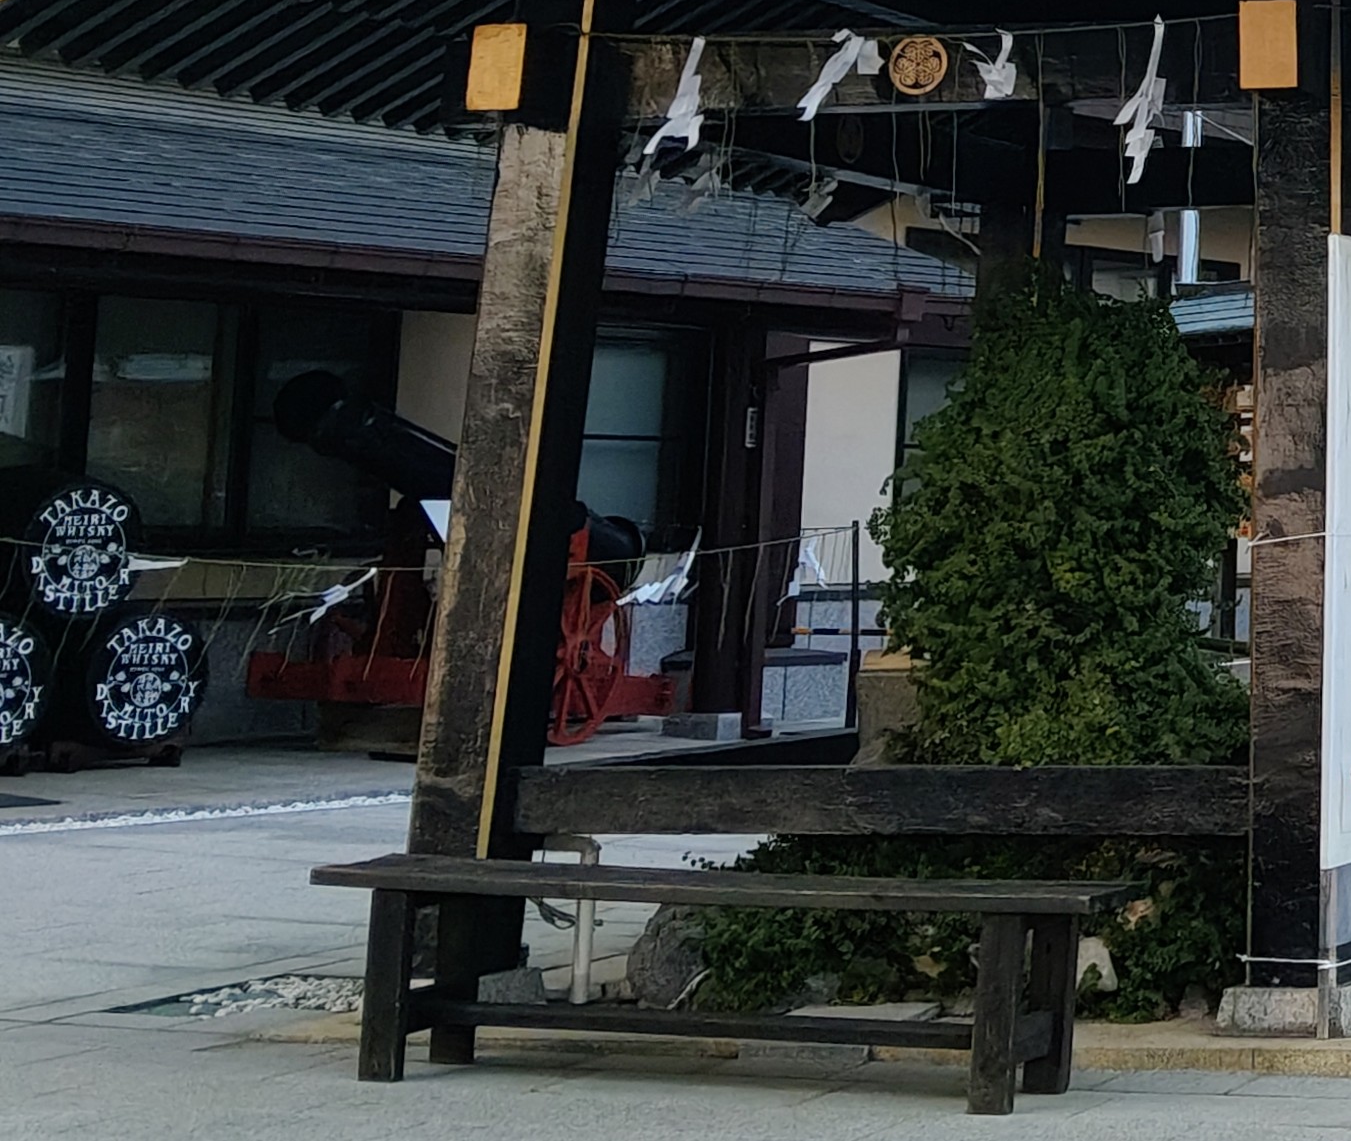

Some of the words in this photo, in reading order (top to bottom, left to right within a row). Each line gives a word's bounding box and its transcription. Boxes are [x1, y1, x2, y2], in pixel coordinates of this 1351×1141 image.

[39, 489, 129, 525] TAKAZO
[64, 514, 106, 526] MEIRI
[55, 524, 115, 537] WHISKY
[31, 556, 131, 613] DISTILLER
[60, 574, 107, 593] MITO
[106, 618, 192, 653] TAKAZO
[128, 642, 171, 655] MEIRI
[121, 653, 179, 665] WHISKY
[95, 681, 200, 740] DISTILLERY
[120, 702, 167, 722] MITO
